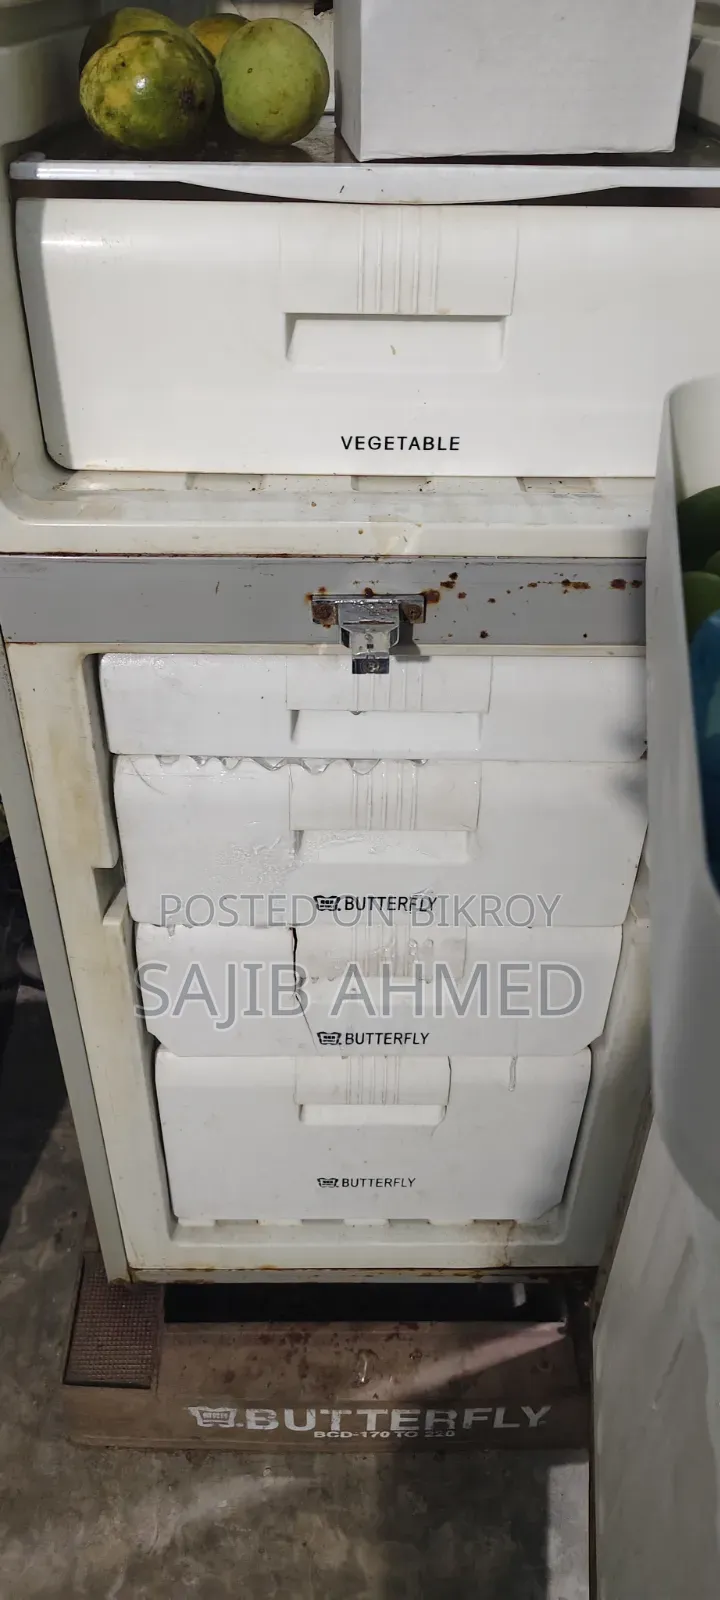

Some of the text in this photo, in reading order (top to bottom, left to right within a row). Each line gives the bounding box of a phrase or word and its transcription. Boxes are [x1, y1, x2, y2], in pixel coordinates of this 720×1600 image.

[340, 435, 460, 451] VEGETABLE
[344, 896, 437, 912] BUTTERFLY
[345, 1032, 430, 1045] BUTTERFLY
[341, 1178, 416, 1188] BUTTERFLY
[245, 1406, 551, 1432] BUTTERFLY
[313, 1430, 390, 1438] BCD-170
